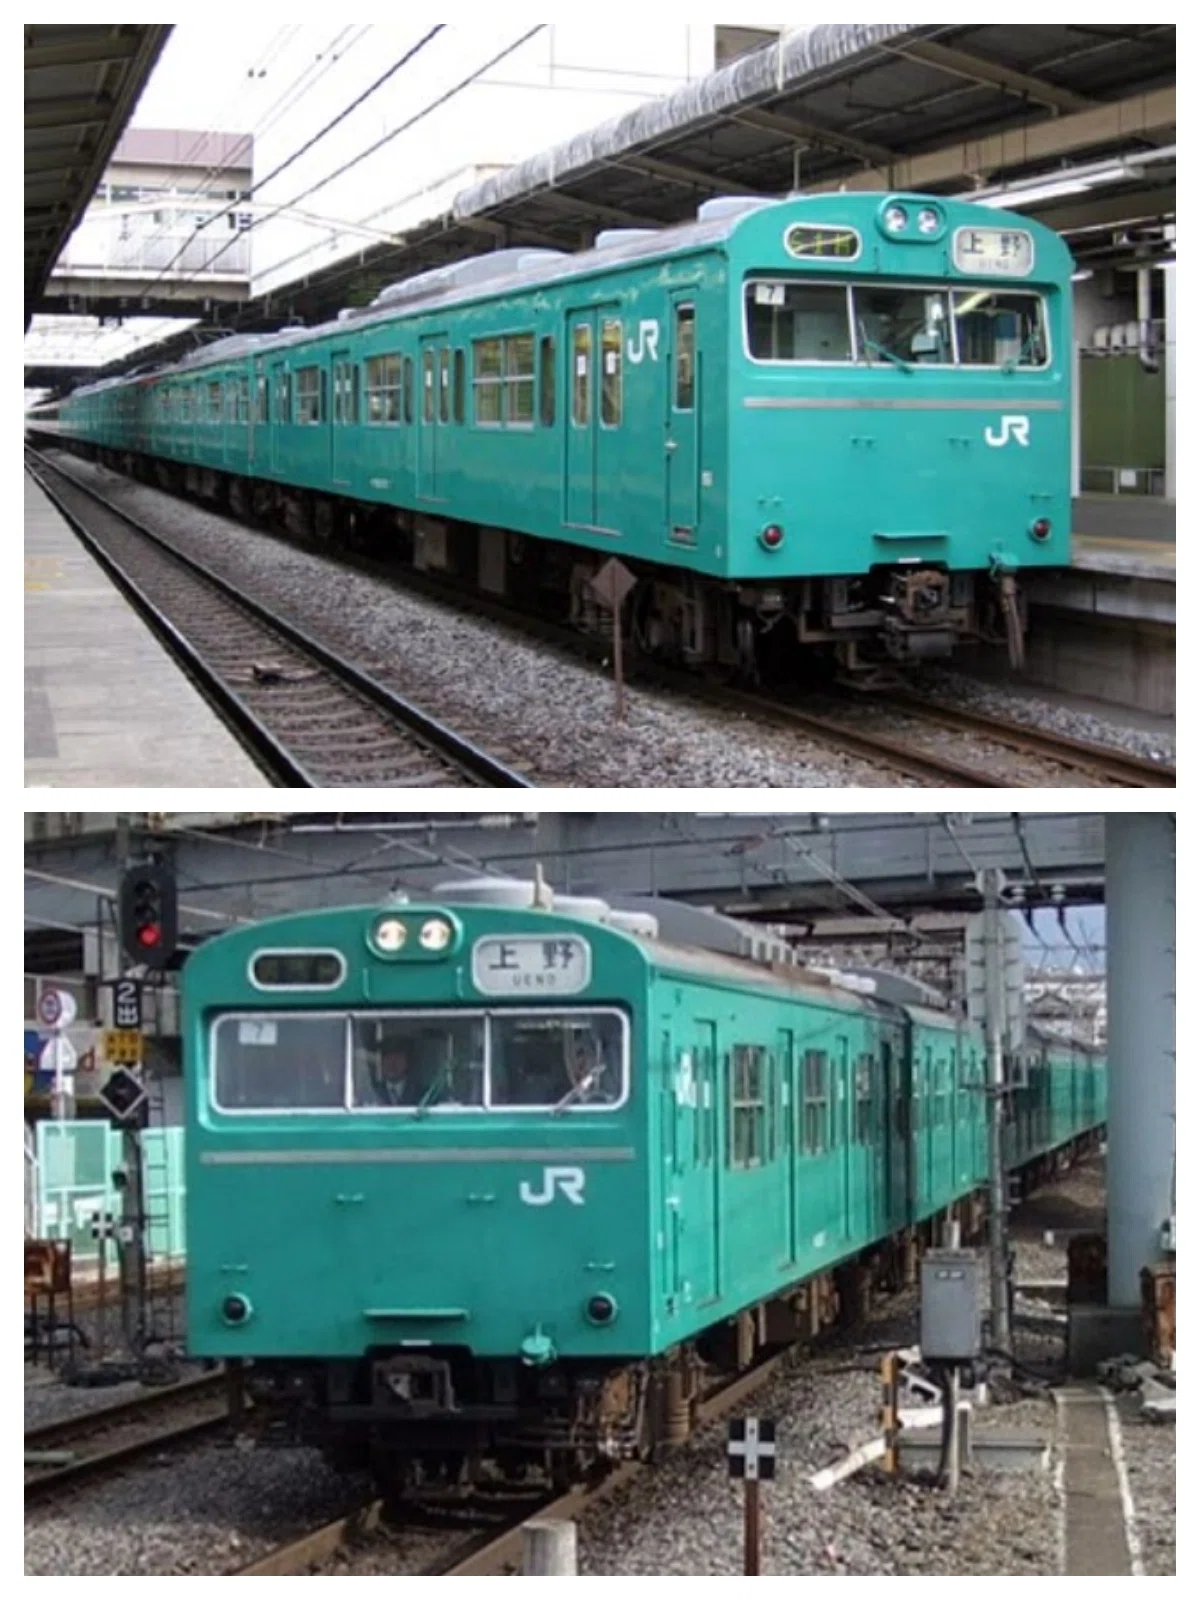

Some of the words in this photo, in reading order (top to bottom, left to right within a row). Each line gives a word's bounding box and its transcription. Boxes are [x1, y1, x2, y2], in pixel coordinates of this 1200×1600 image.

[962, 232, 1021, 257] 上野
[627, 318, 659, 363] JR
[985, 415, 1030, 447] JR
[488, 940, 574, 970] 上野
[520, 1166, 585, 1206] JR
